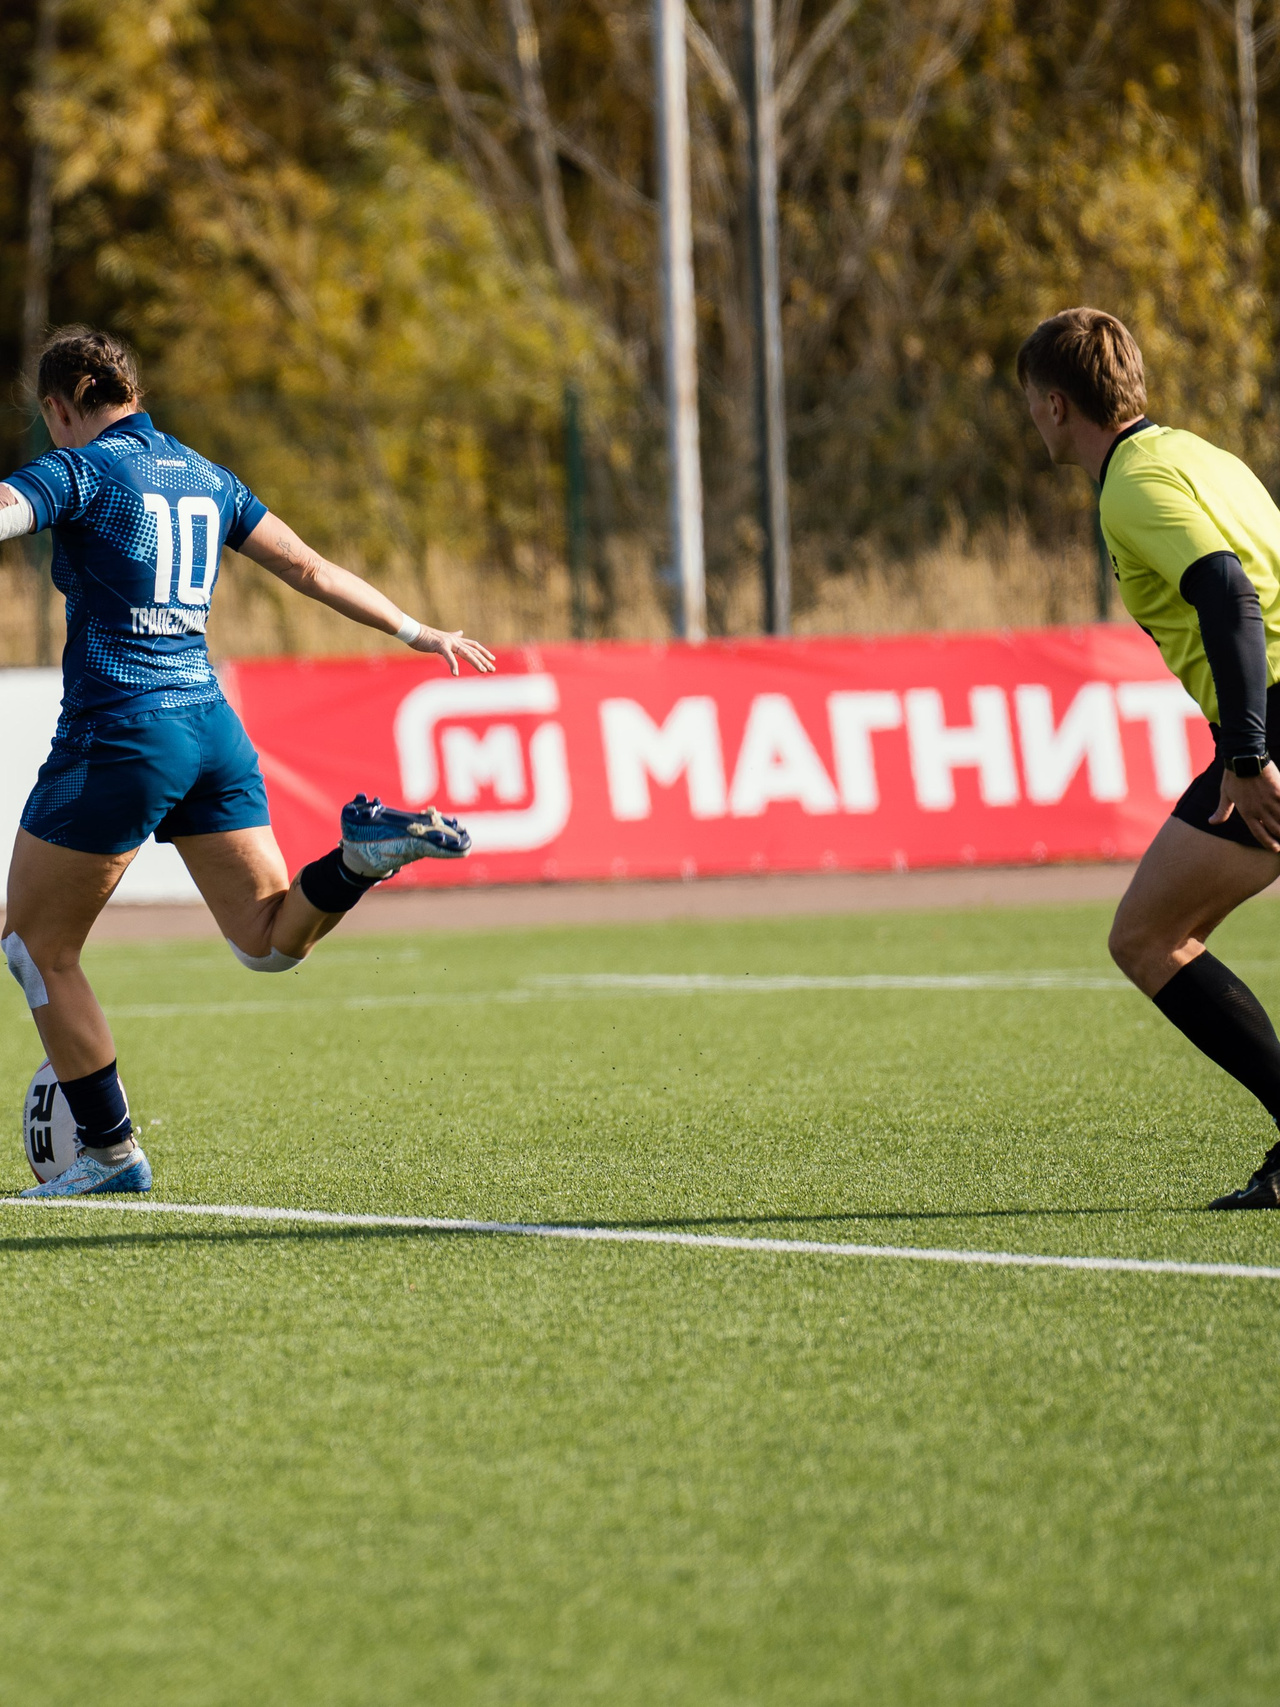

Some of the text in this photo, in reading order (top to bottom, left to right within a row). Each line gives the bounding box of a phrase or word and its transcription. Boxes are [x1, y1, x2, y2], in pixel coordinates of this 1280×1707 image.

[143, 493, 219, 604] 10
[599, 682, 1206, 820] МАГНИТ
[30, 1082, 58, 1163] R3
